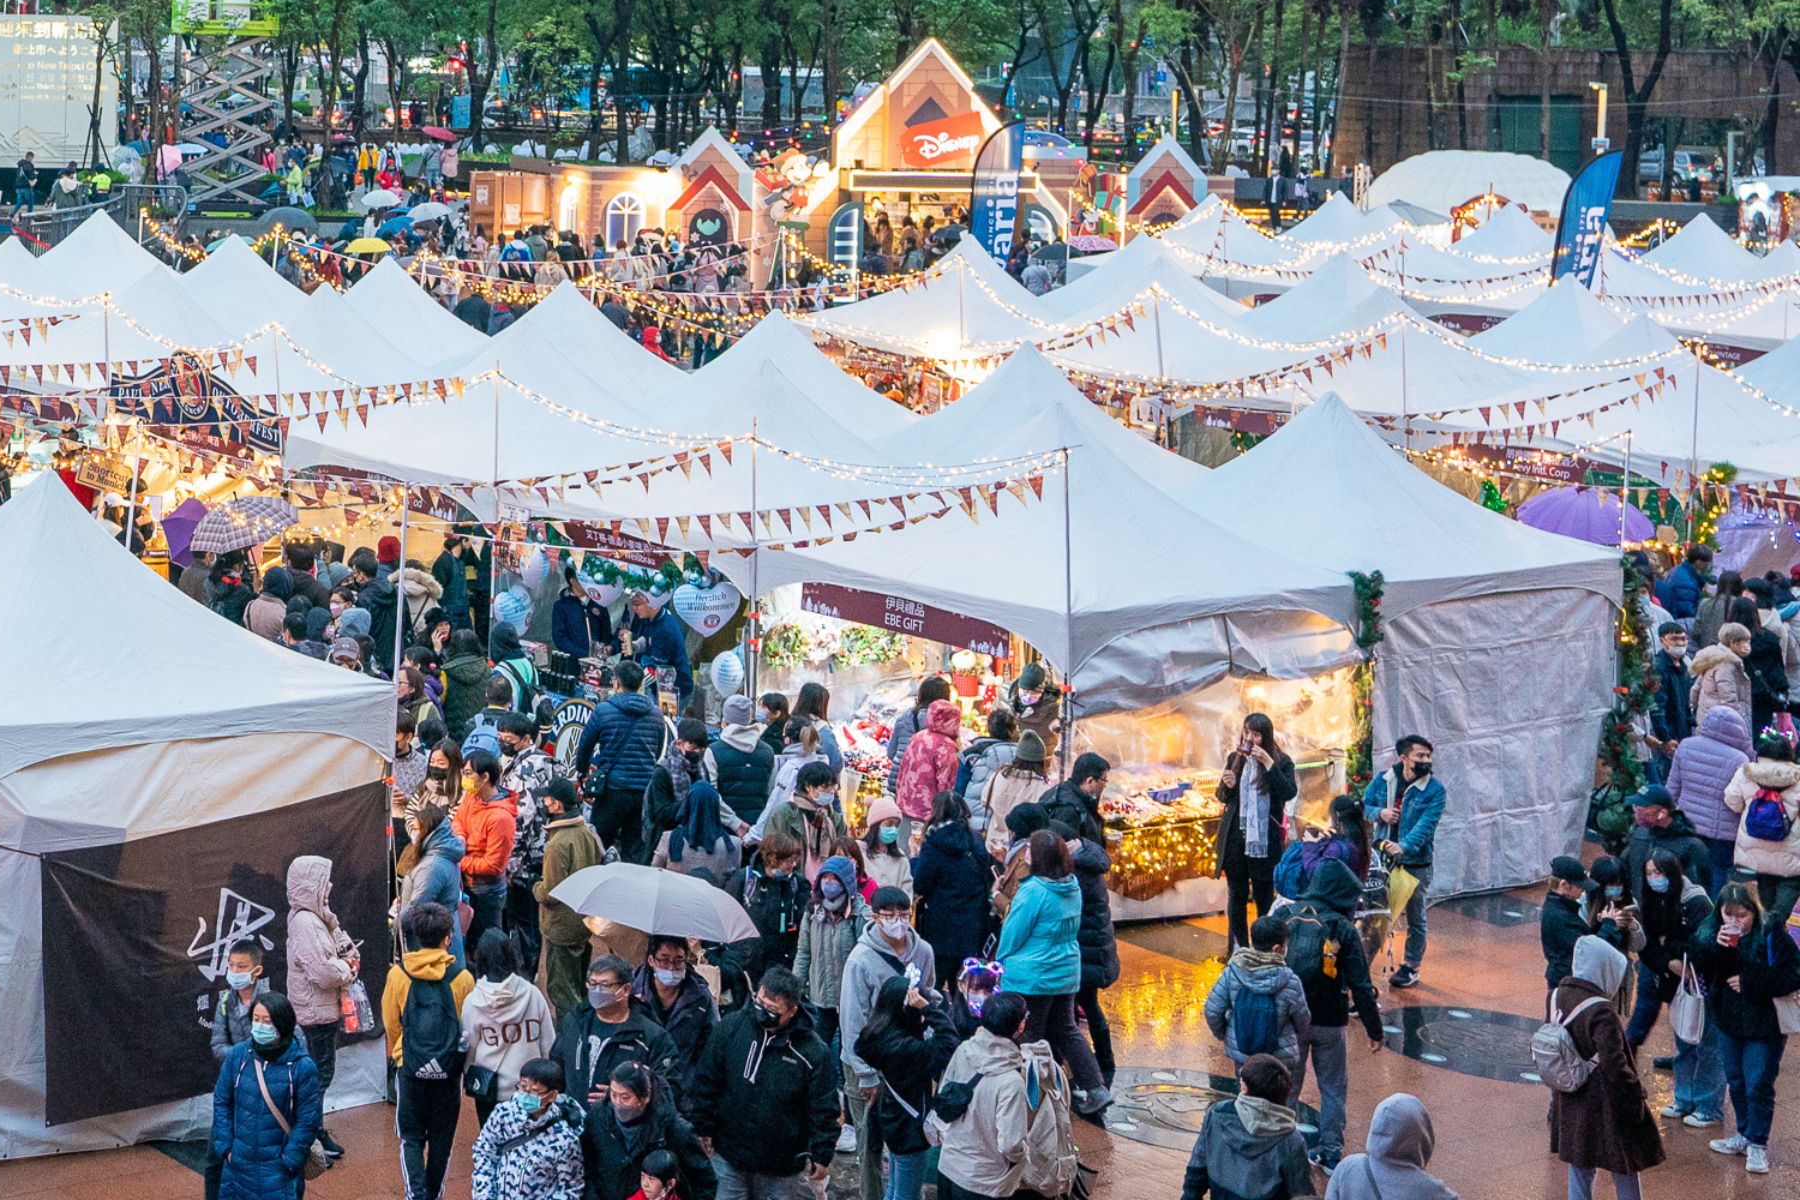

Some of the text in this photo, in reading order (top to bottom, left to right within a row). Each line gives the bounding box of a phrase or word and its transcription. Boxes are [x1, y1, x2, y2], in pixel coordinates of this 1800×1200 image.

[913, 131, 980, 160] Disney
[118, 379, 170, 401] PAULNER
[1549, 467, 1571, 480] Corp
[885, 596, 925, 618] 伊貝禮品
[884, 612, 924, 633] EBE GIFT
[551, 704, 592, 737] ERDIN
[415, 1071, 449, 1080] adidas
